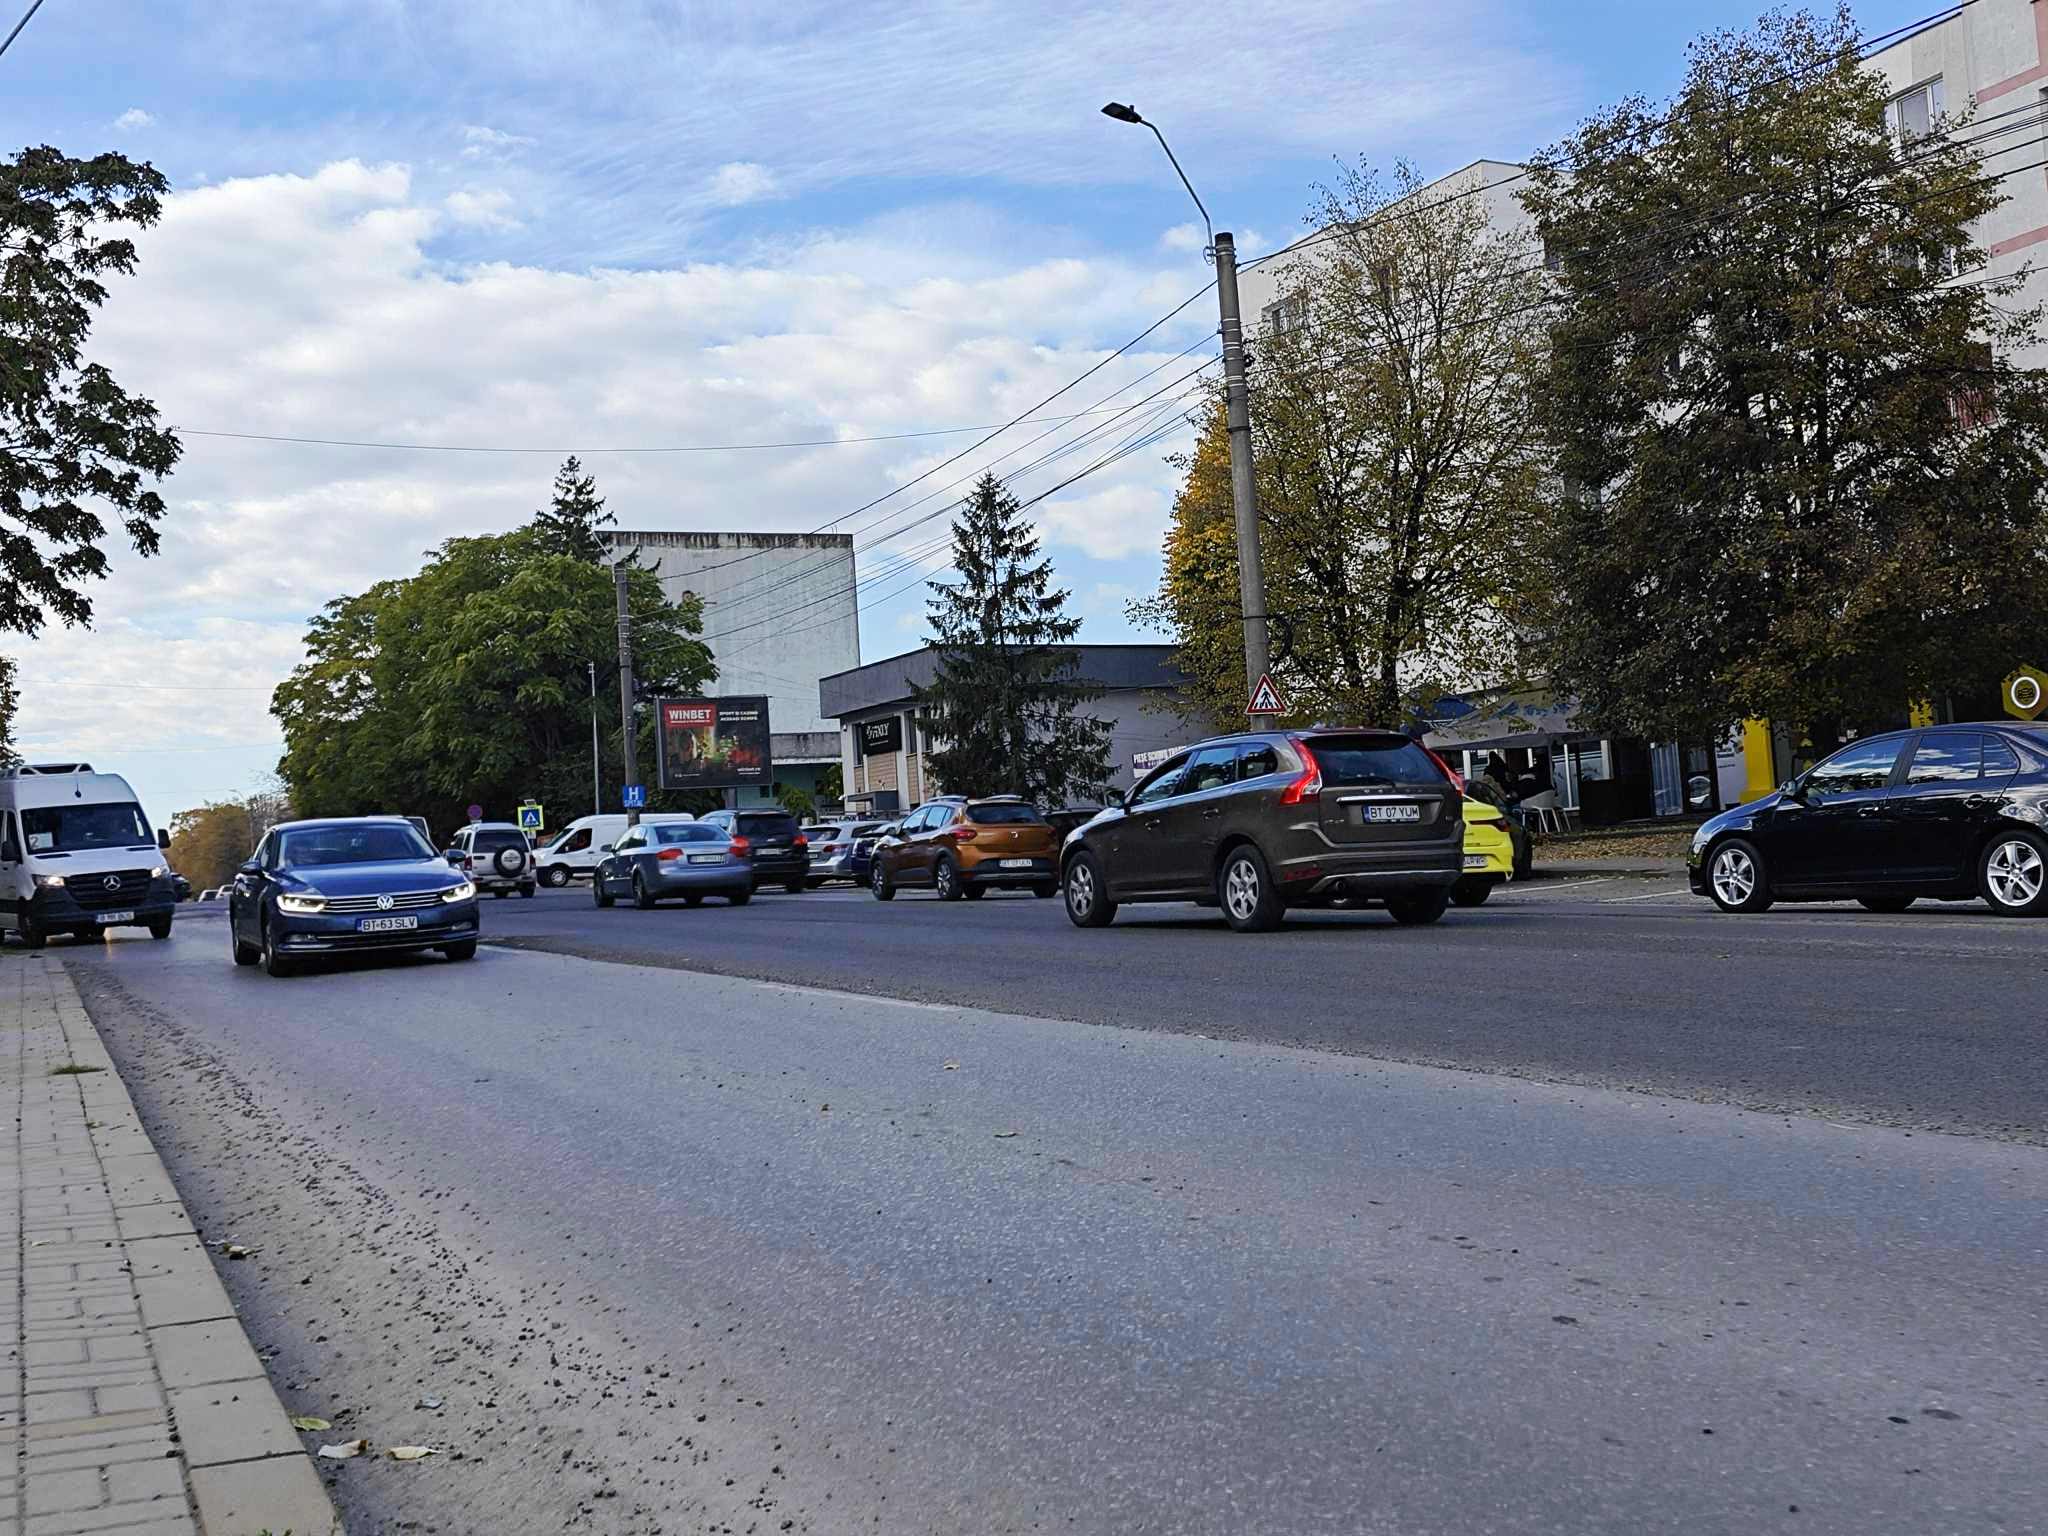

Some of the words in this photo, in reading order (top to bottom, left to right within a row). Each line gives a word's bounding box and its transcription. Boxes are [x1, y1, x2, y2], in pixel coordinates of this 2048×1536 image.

[668, 708, 712, 720] WINBET
[628, 786, 639, 801] H
[1370, 807, 1383, 818] BT
[1386, 807, 1397, 818] 07
[1398, 806, 1419, 818] YUM
[394, 917, 416, 928] SLV
